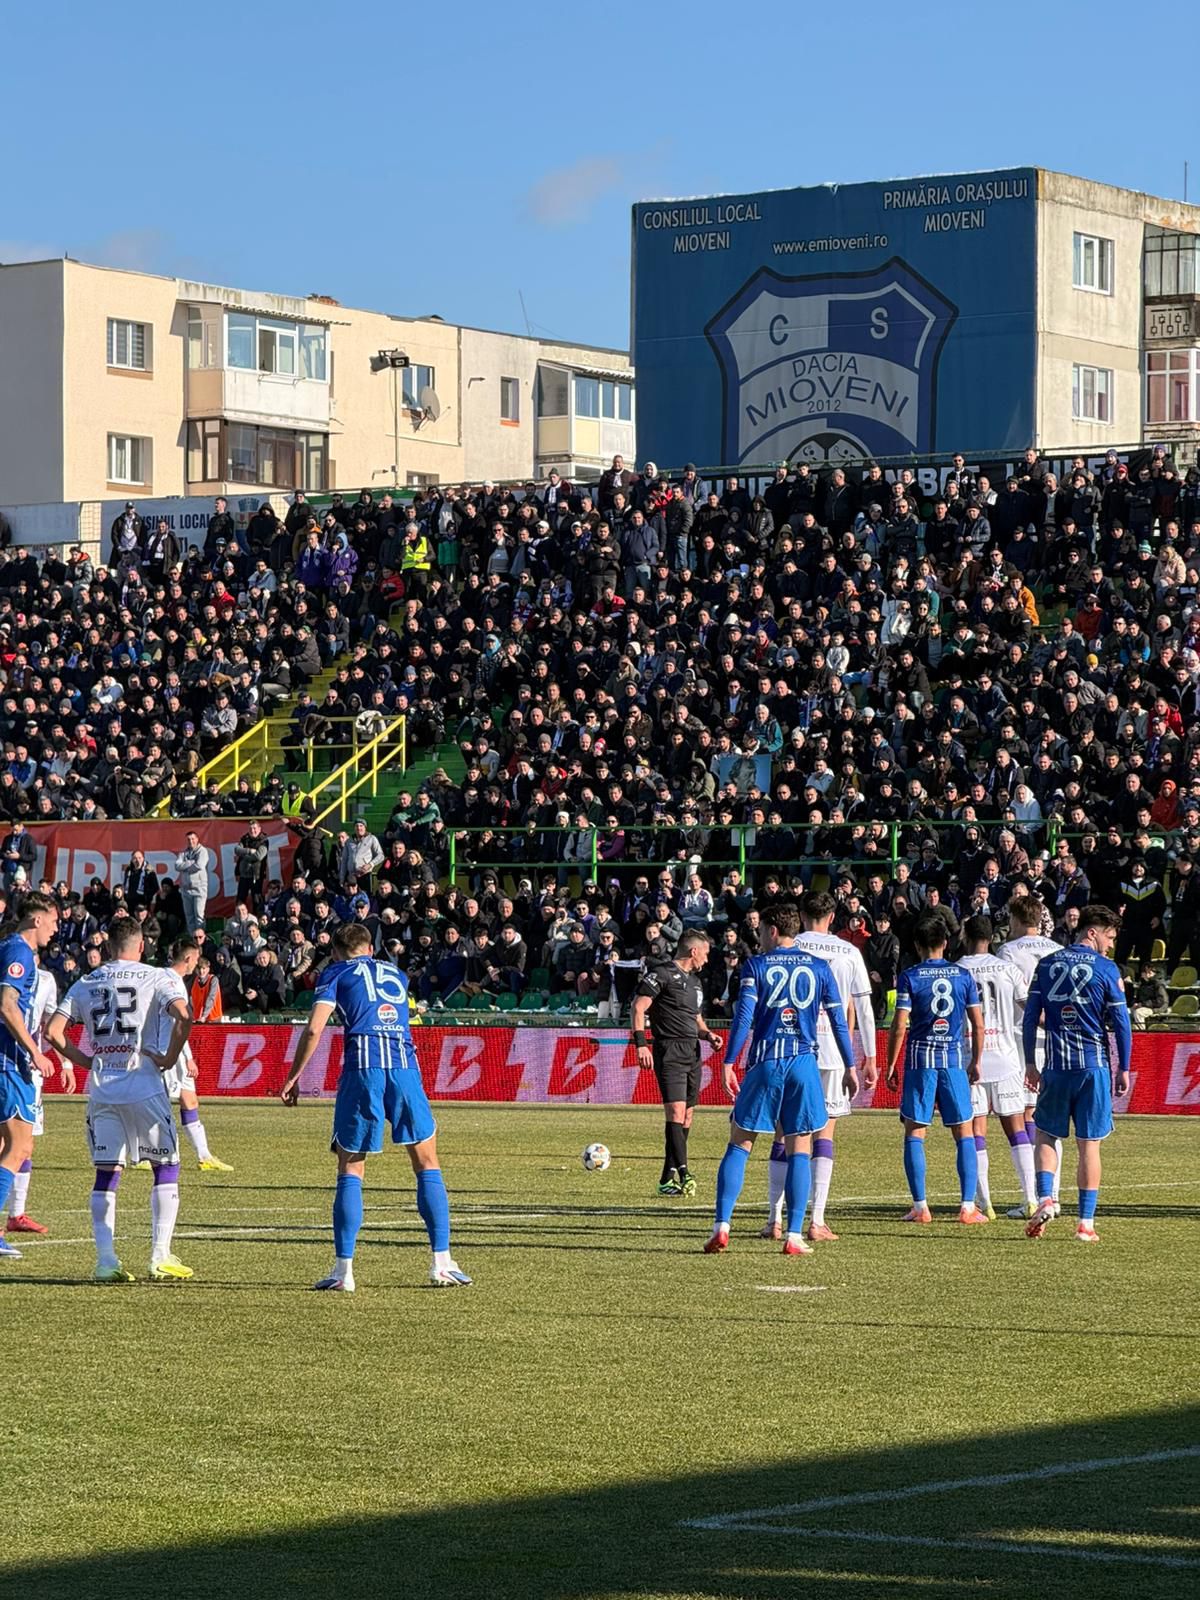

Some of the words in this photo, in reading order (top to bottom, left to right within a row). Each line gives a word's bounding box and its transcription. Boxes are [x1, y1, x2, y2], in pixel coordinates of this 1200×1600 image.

[883, 184, 951, 210] PRIMĂRIA
[643, 207, 713, 230] CONSILIUL
[717, 202, 762, 224] LOCAL
[923, 209, 986, 233] MIOVENI
[673, 231, 731, 254] MIOVENI
[772, 233, 888, 255] www.emioveni.ro
[769, 313, 789, 346] C
[870, 306, 889, 340] S
[792, 353, 859, 378] DACIA
[745, 375, 910, 427] MIOVENI
[807, 399, 841, 414] 2012
[33, 832, 290, 902] UPERBET
[801, 941, 841, 953] METABET
[842, 947, 852, 955] CF
[353, 962, 407, 1004] 15
[766, 965, 816, 1009] 20
[930, 978, 955, 1018] 8
[1047, 961, 1093, 1004] 22
[90, 986, 138, 1036] 22
